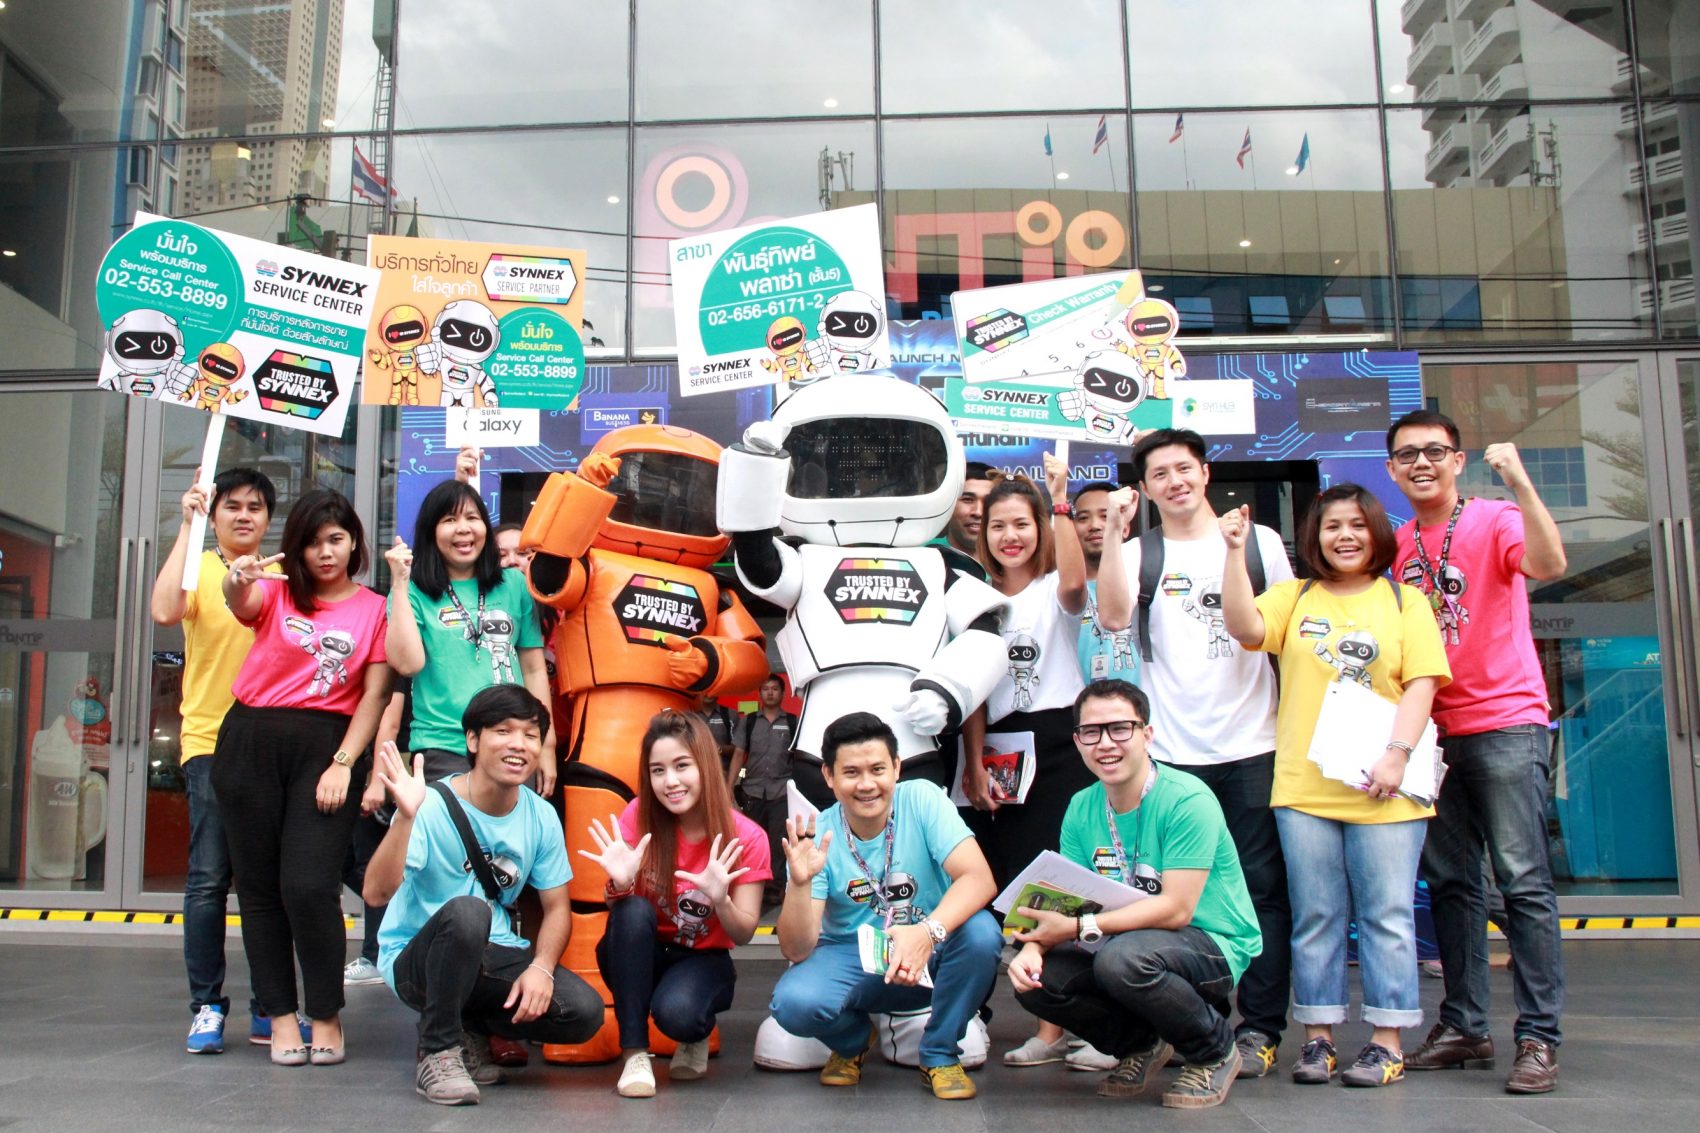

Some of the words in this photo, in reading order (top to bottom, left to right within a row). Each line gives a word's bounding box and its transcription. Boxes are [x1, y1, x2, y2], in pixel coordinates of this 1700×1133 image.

[156, 230, 198, 255] มั่นใจ
[140, 249, 208, 273] พร้อมบริการ
[677, 243, 712, 262] สาขา
[723, 238, 816, 274] พันธุ์ทิพย์
[376, 251, 478, 275] บริการทั่วไทย
[120, 259, 158, 275] Service
[161, 269, 181, 281] Call
[184, 275, 219, 289] Center
[281, 266, 368, 298] SYNNEX
[509, 267, 565, 281] SYNNEX
[740, 268, 802, 297] พลาซ่า
[808, 267, 841, 285] (ชั้น5)
[105, 268, 228, 310] 02-553-8899
[497, 281, 525, 293] SERVICE
[529, 282, 560, 295] PARTNER
[254, 280, 309, 303] SERVICE
[314, 294, 363, 316] CENTER
[1028, 304, 1068, 325] Check
[1066, 283, 1119, 309] Warranty
[708, 293, 825, 326] 02-656-6171-2
[248, 307, 348, 337] การบริการหลังการขาย
[521, 320, 554, 339] มั่นใจ
[974, 318, 1024, 345] SYNNEX
[510, 340, 563, 352] พร้อมบริการ
[496, 353, 526, 362] Service
[528, 354, 545, 363] Call
[547, 355, 575, 364] Center
[703, 358, 751, 374] SYNNEX
[890, 354, 944, 363] AUNCH
[1048, 354, 1059, 363] 5
[271, 369, 311, 386] TRUSTED
[313, 377, 326, 388] BY
[491, 363, 577, 379] 02-553-8899
[690, 374, 723, 387] SERVICE
[724, 370, 753, 383] CENTER
[258, 377, 332, 403] SYNNEX
[982, 390, 1049, 405] SYNNEX
[963, 403, 1006, 416] SERVICE
[1009, 408, 1049, 420] CENTER
[463, 418, 522, 435] alaxy
[844, 575, 894, 588] TRUSTED
[896, 576, 911, 589] BY
[633, 593, 678, 612] TRUSTED
[680, 601, 694, 616] BY
[834, 586, 921, 604] SYNNEX
[622, 603, 701, 632] SYNNEX
